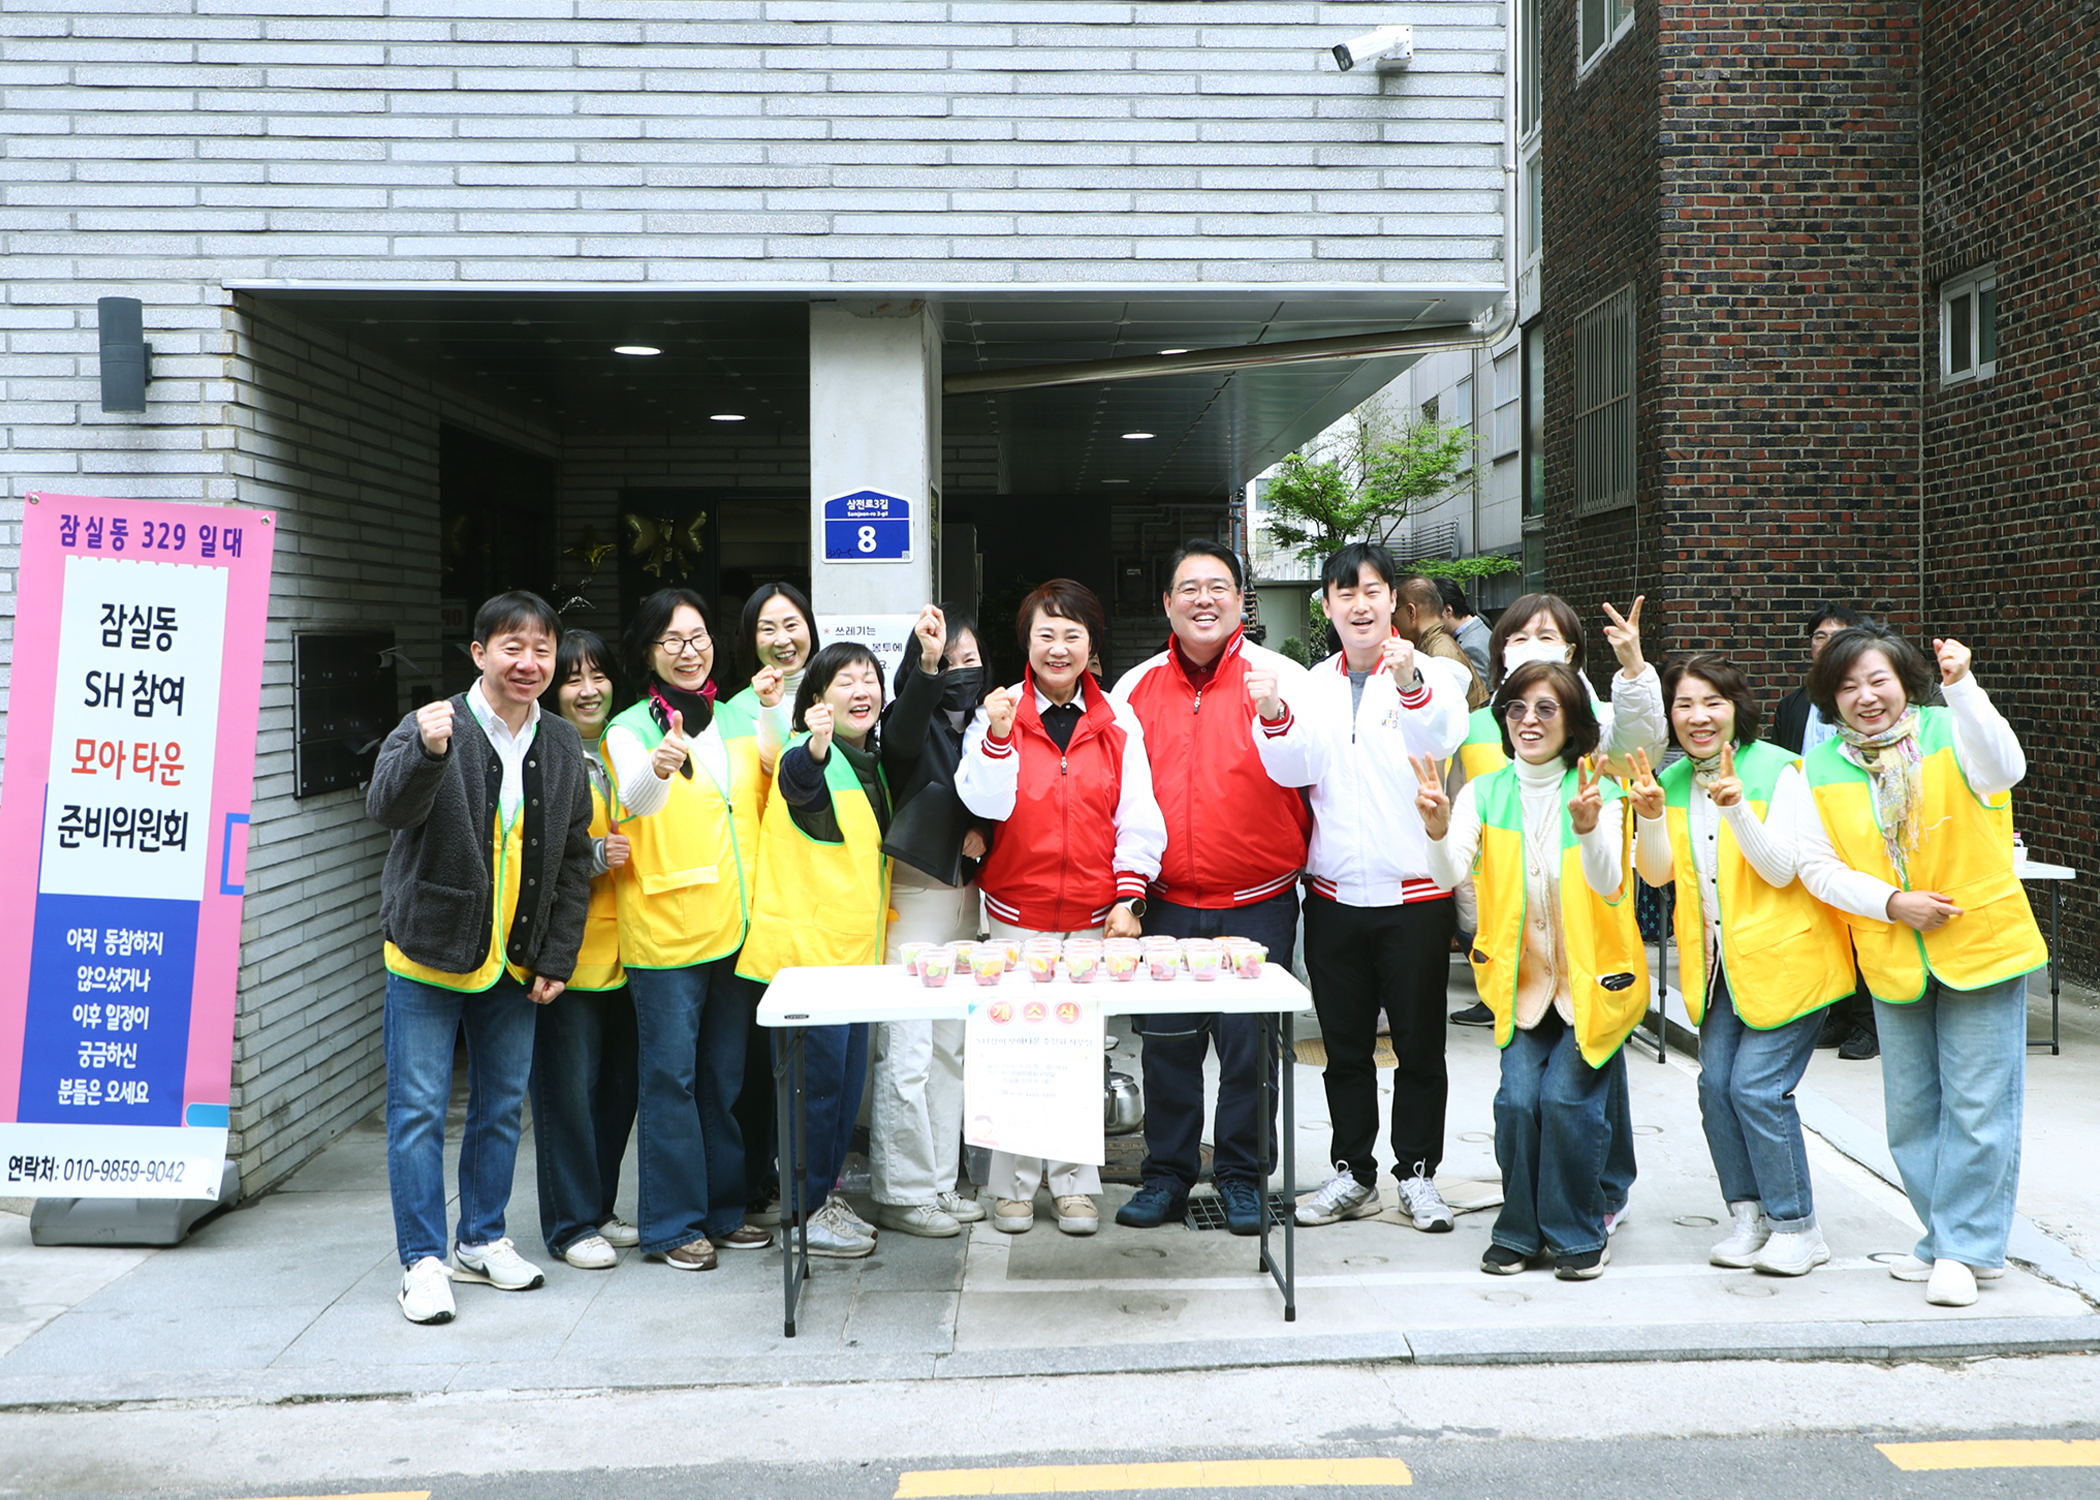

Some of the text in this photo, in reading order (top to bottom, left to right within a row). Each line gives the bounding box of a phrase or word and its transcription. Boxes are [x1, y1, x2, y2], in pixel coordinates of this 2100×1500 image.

[846, 498, 889, 510] 삼전로3길
[60, 514, 243, 558] 잠실동 329 일대
[857, 525, 877, 553] 8
[100, 603, 178, 652] 잠실동
[835, 626, 876, 636] 쓰레기는
[84, 669, 185, 717] SH 참여
[71, 738, 184, 786] 모아 타운
[58, 804, 189, 852] 준비위원회
[66, 927, 164, 956] 아직 동참하지
[77, 965, 151, 993] 않으셨거나
[72, 1003, 149, 1031] 이후 일정이
[77, 1041, 138, 1069] 궁금하신
[58, 1078, 149, 1106] 분들은 오세요
[8, 1155, 186, 1183] 연락처: 010-9859-9042
